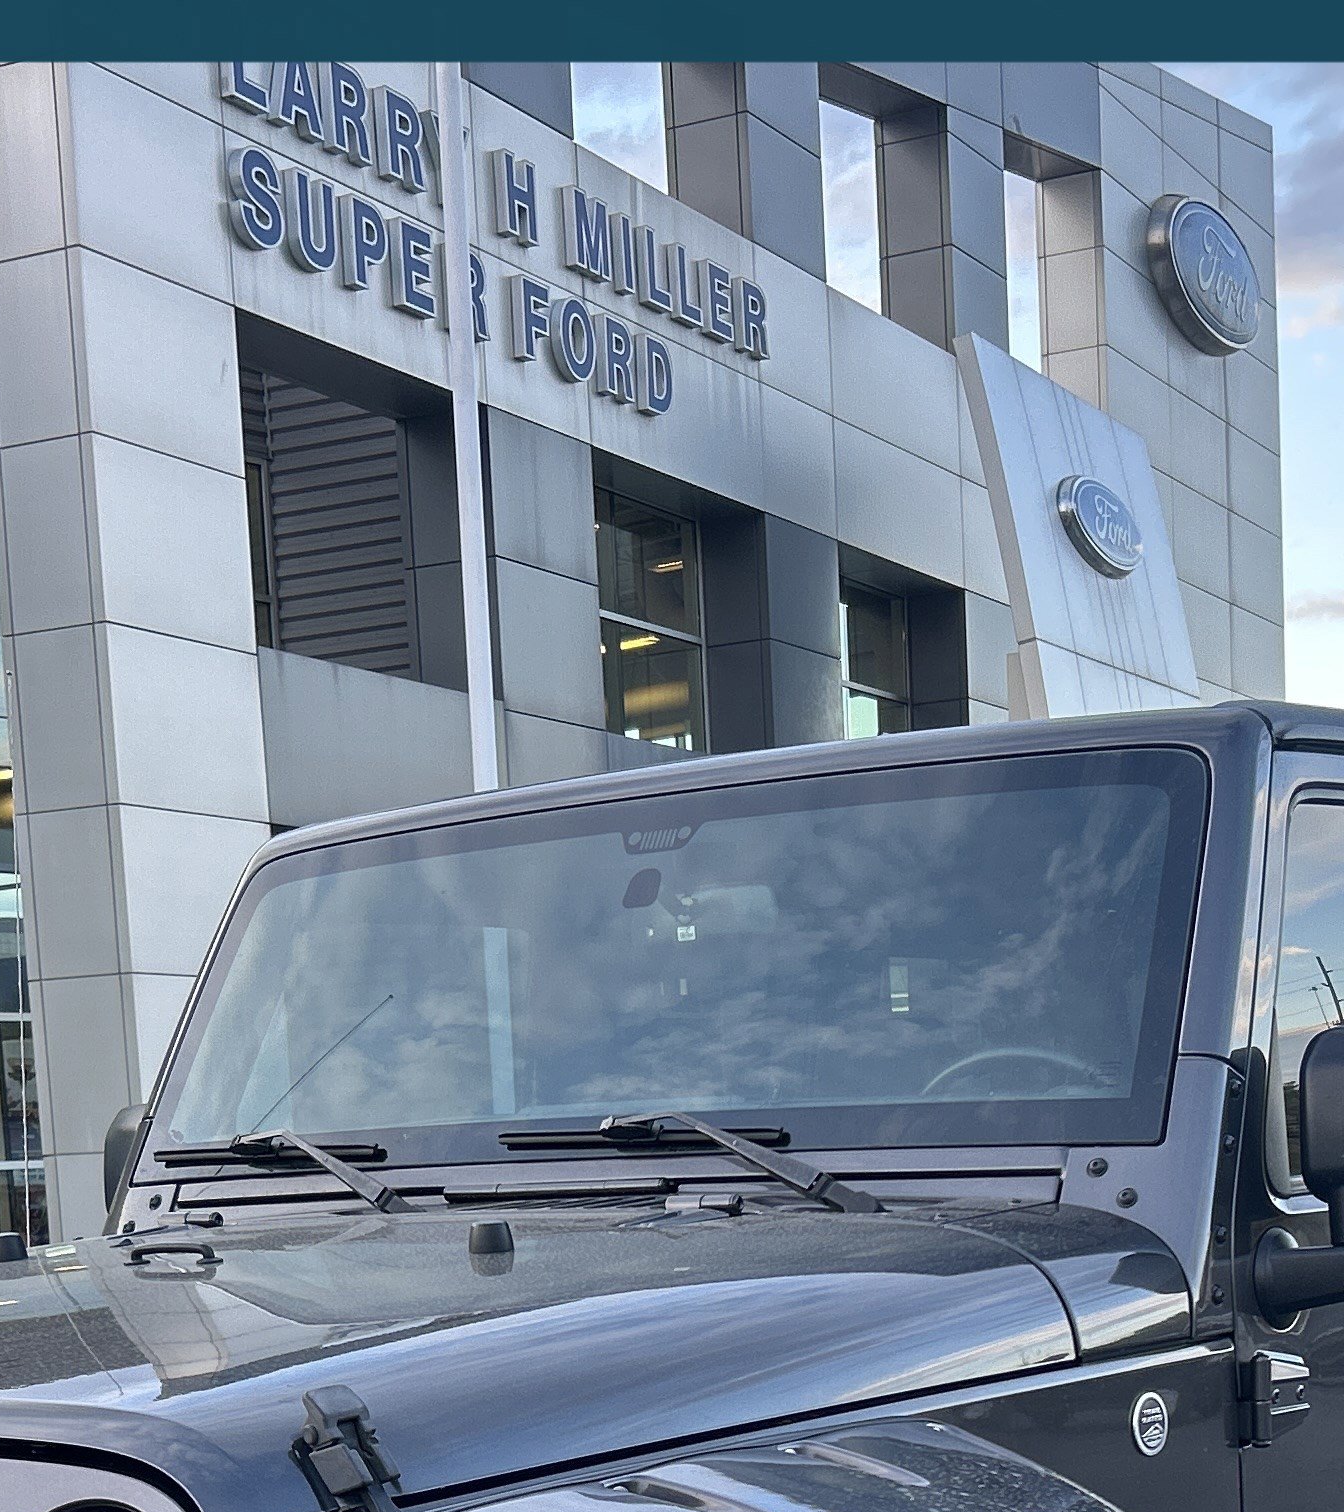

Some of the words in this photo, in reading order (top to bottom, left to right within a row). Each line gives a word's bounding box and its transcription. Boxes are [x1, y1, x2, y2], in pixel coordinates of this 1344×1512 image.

[221, 62, 469, 206] LARR
[492, 148, 539, 248] H
[561, 184, 770, 360] MILLER
[1196, 225, 1250, 323] Ford
[511, 273, 674, 416] FORD
[1093, 493, 1134, 553] Ford
